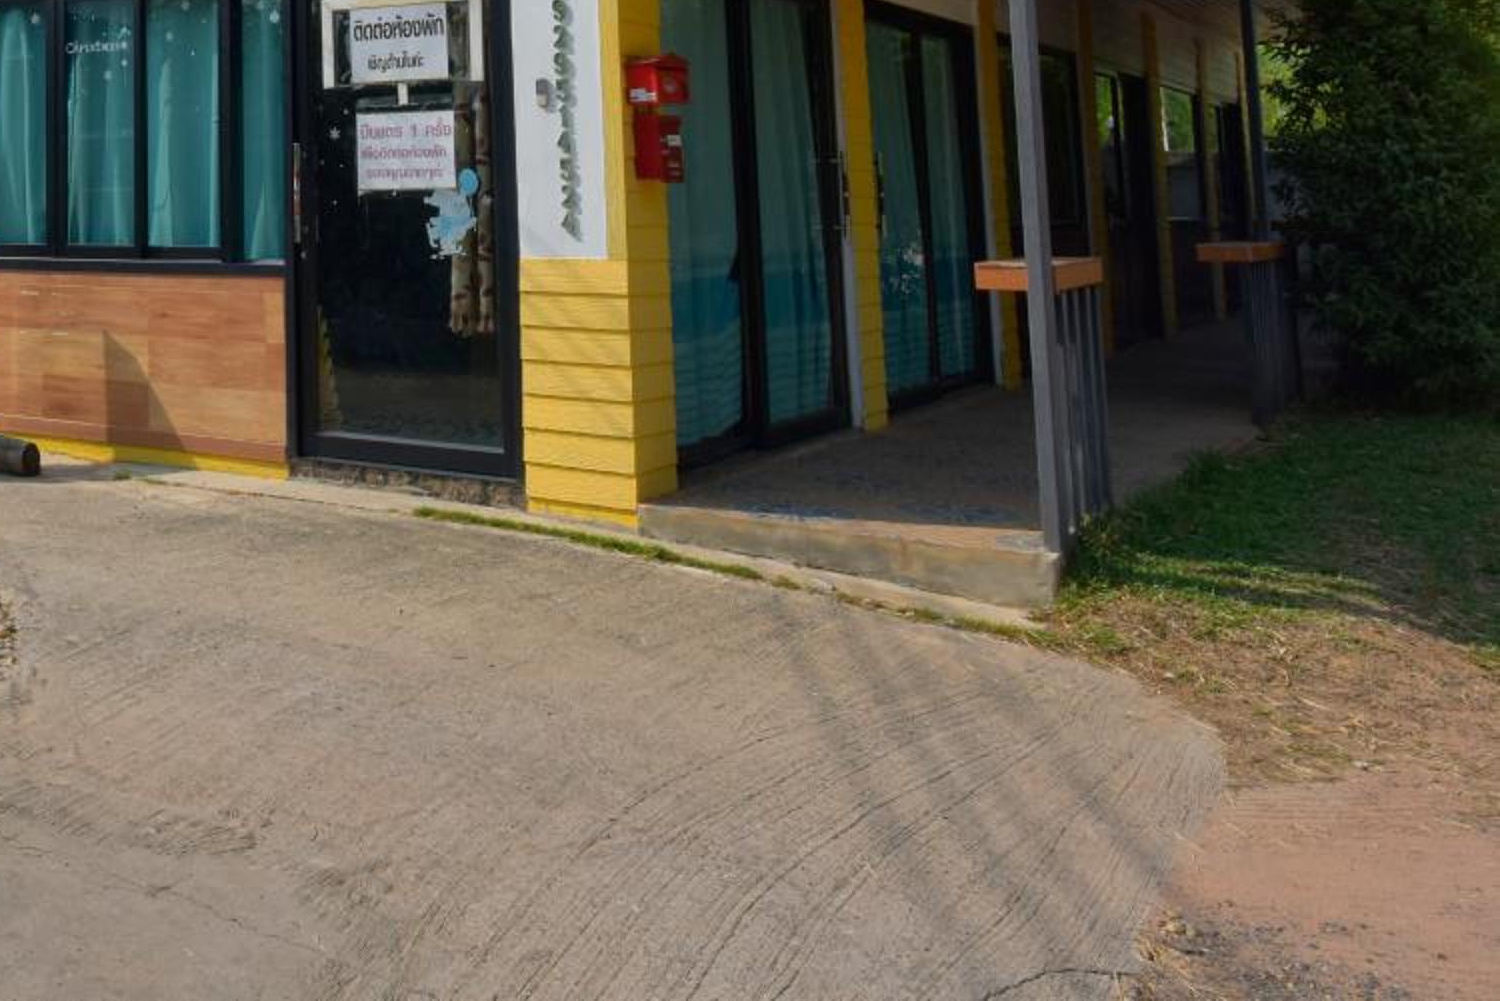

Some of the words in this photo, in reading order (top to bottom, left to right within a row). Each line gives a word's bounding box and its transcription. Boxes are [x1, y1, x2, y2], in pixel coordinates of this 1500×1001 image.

[353, 12, 445, 41] ติดต่อห้องพัก
